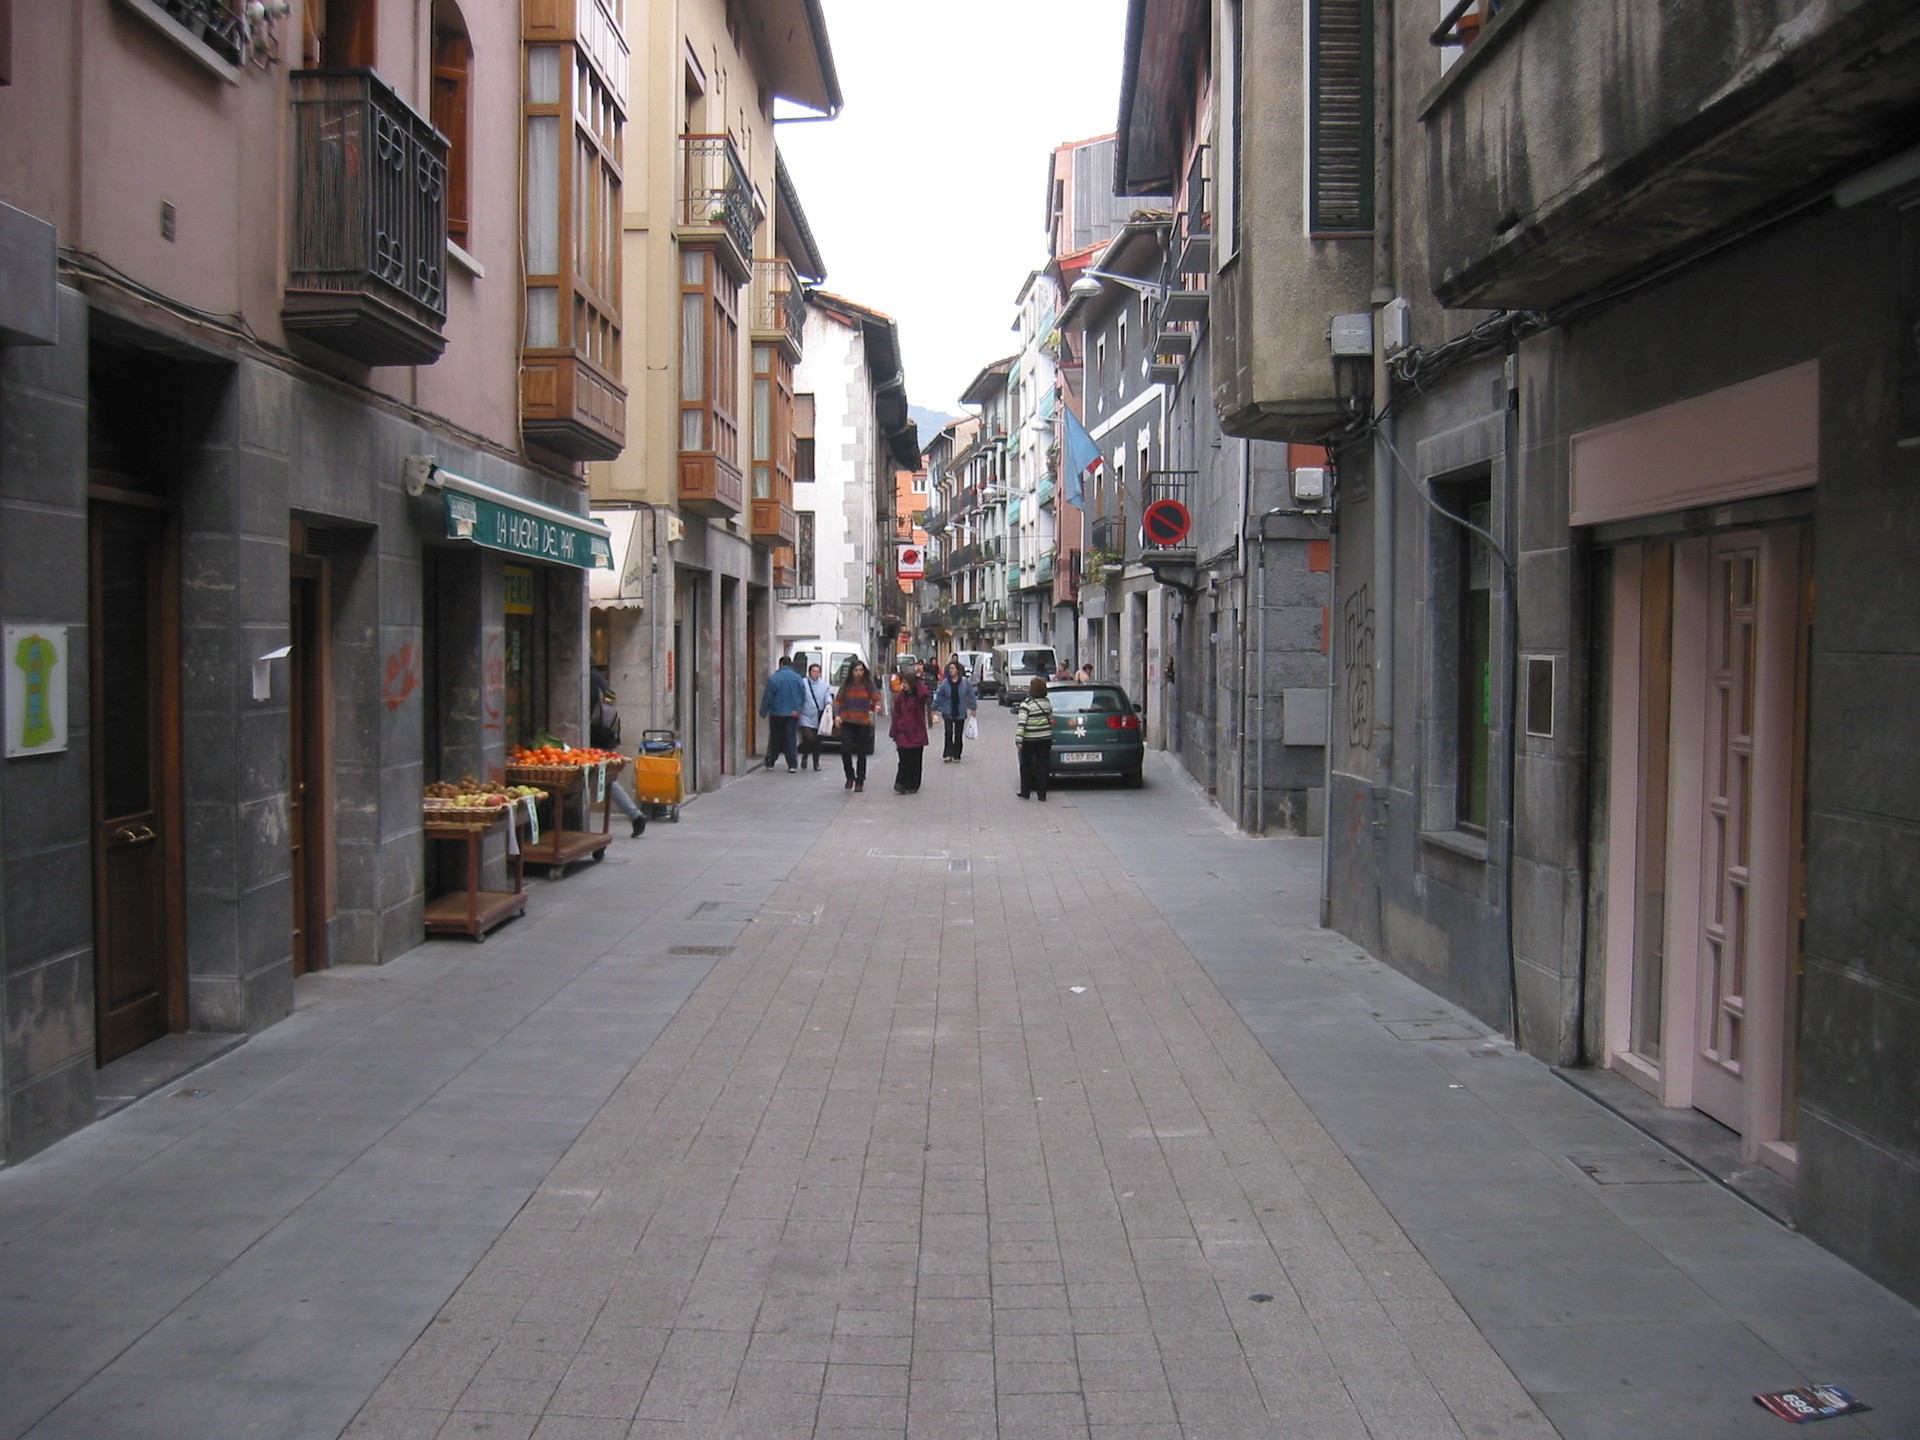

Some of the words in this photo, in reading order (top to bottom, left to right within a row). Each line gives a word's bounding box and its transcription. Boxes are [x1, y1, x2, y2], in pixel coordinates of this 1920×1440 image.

[496, 511, 507, 544] LA
[509, 514, 539, 551] HUERTA
[542, 525, 559, 556] DEL
